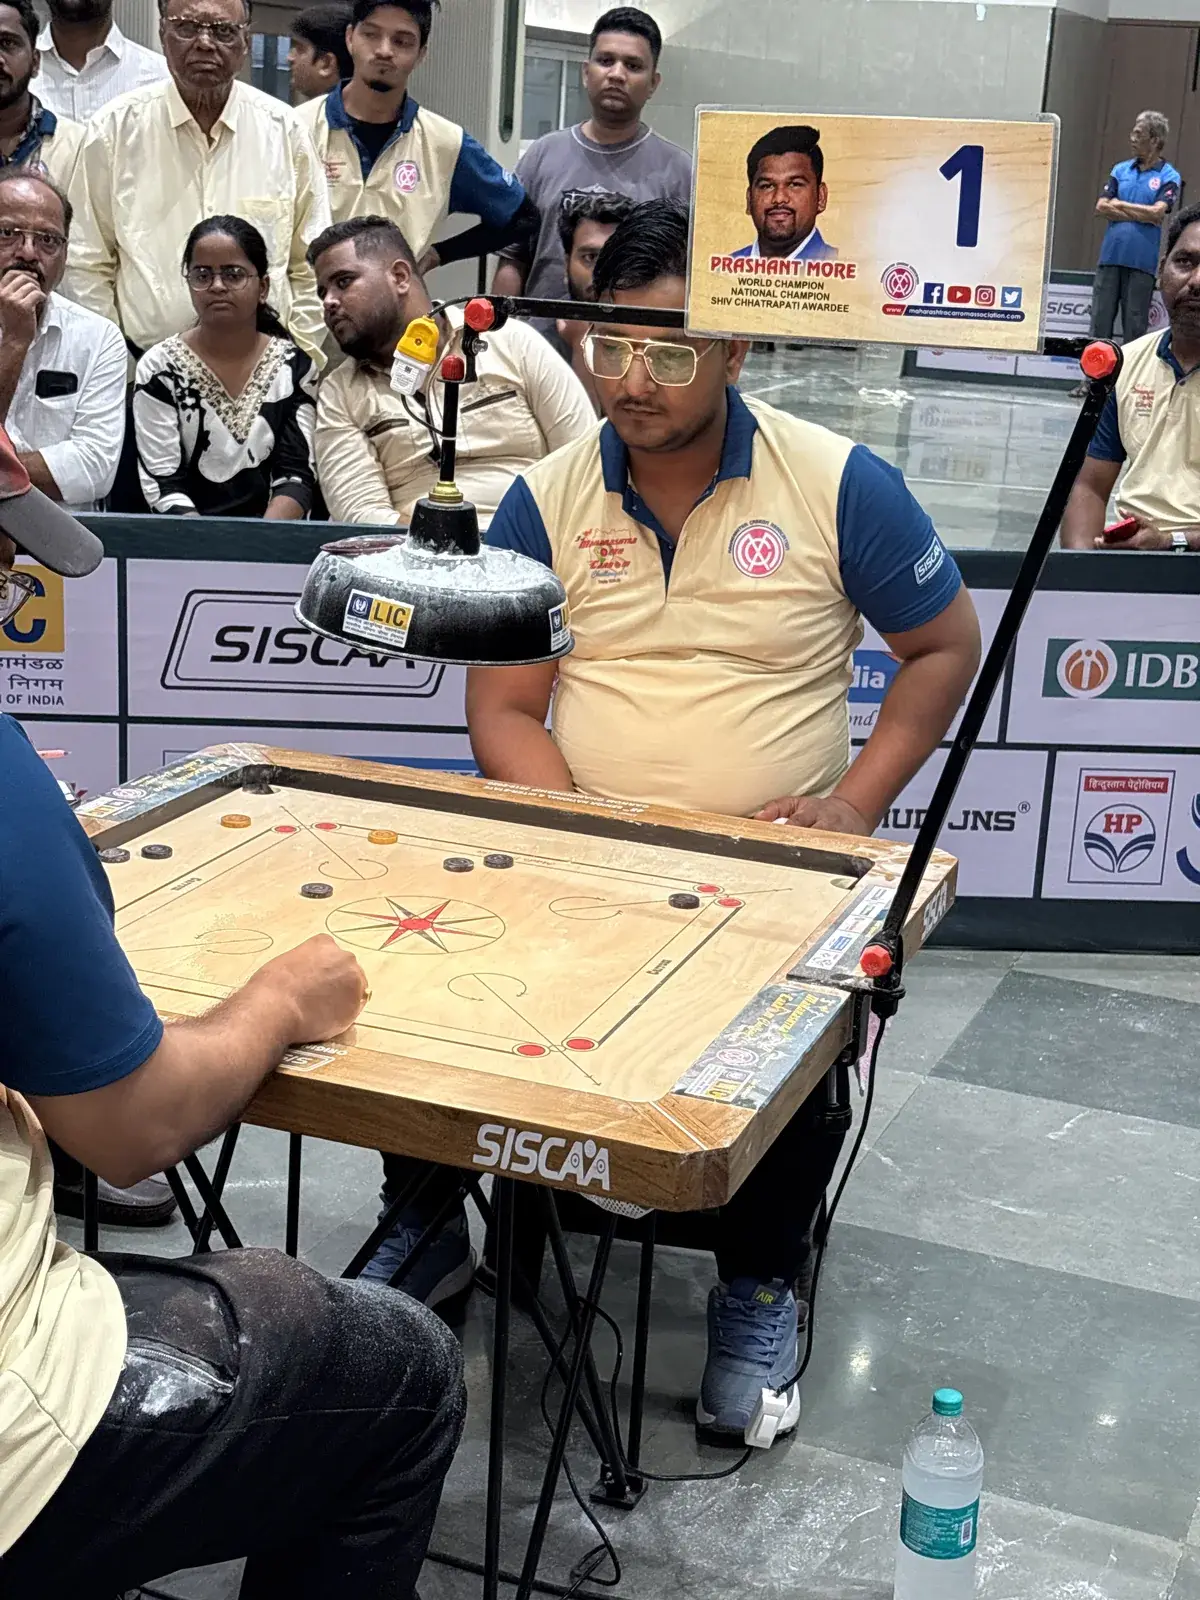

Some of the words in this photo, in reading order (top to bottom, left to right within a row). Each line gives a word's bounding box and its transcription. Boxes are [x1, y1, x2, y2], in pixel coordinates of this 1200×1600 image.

[938, 144, 984, 248] 1
[710, 256, 802, 276] PRASHANT
[806, 261, 857, 280] MORE
[737, 277, 773, 288] WORLD
[774, 279, 825, 290] CHAMPION
[730, 287, 777, 299] NATIONAL
[780, 289, 831, 301] CHAMPION
[710, 296, 733, 307] SHIV
[734, 298, 800, 311] CHHATRAPATI
[801, 302, 850, 313] AWARDEE
[1046, 301, 1093, 316] SISCA
[908, 308, 1022, 320] maharashtracarromassociation.com
[373, 601, 407, 628] LIC
[209, 625, 416, 669] SISC
[7, 673, 65, 691] निगम
[6, 693, 23, 705] OF
[27, 694, 65, 706] INDIA
[1102, 813, 1143, 834] HP
[472, 1123, 611, 1192] SISCAA
[756, 1291, 774, 1305] AIR
